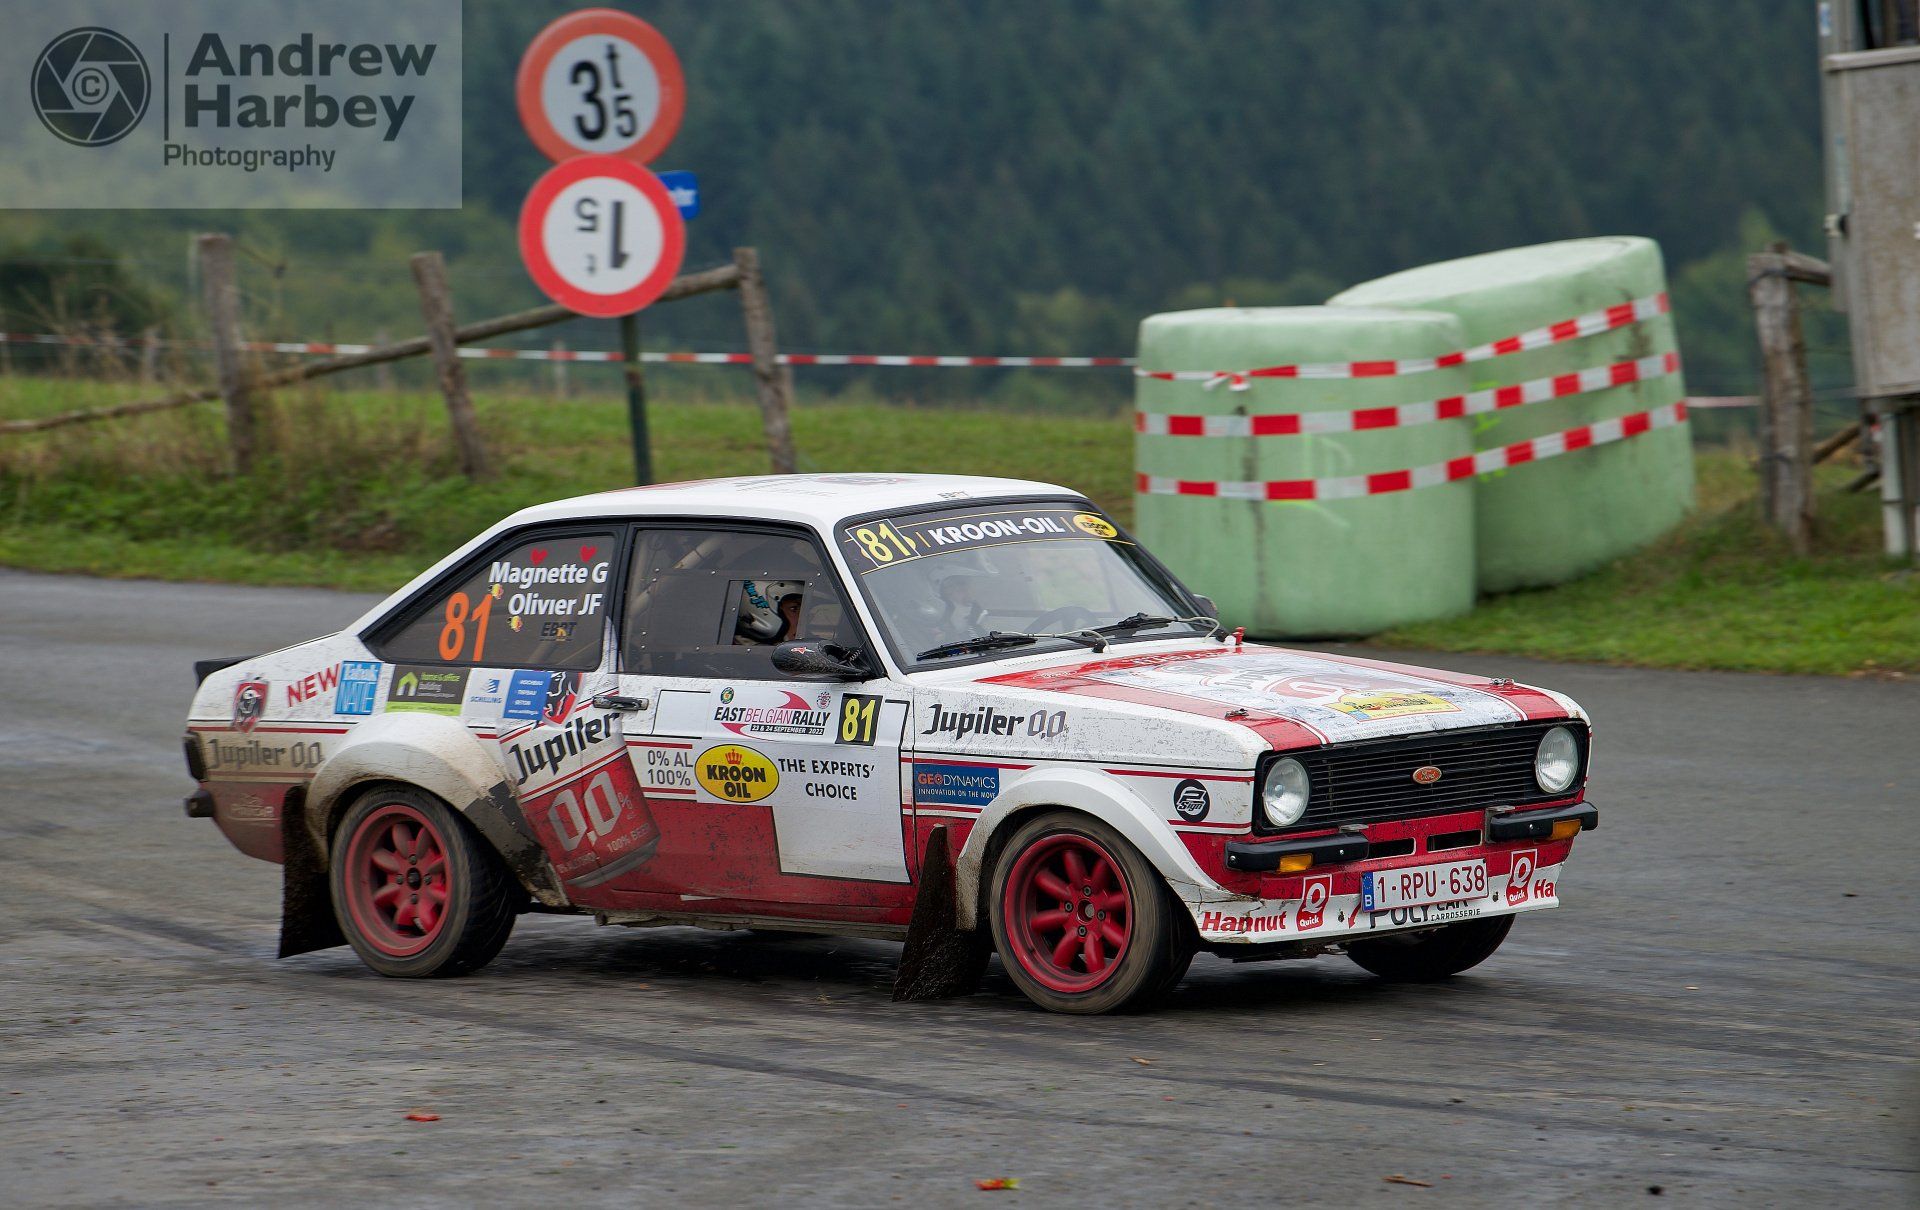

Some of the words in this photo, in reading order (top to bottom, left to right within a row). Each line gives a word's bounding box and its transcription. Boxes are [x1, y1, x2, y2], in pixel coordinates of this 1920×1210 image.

[927, 517, 1065, 546] KROON-OIL
[856, 523, 912, 562] 81
[489, 561, 588, 589] Magnette
[592, 562, 609, 583] G
[508, 593, 577, 616] Olivier
[578, 593, 603, 616] JF
[438, 591, 493, 662] 81
[287, 664, 340, 707] NEW
[773, 726, 807, 734] SEPTEMBER
[842, 698, 876, 742] 81
[920, 703, 1024, 741] Jupiler
[207, 738, 287, 769] Jupiler
[507, 711, 621, 786] Jupiler
[647, 749, 670, 767] 0%
[647, 769, 691, 787] 100%
[706, 764, 767, 783] KROON
[778, 757, 807, 773] THE
[812, 759, 875, 779] EXPERTS'
[724, 781, 751, 798] OIL
[917, 772, 996, 789] GEODYNAMICS
[805, 782, 857, 801] CHOICE
[918, 788, 956, 796] INNOVATION
[968, 790, 979, 798] THE
[1177, 800, 1203, 812] Sign
[1377, 864, 1485, 903] 1-RPU-638
[1533, 879, 1555, 899] Ha
[1364, 894, 1372, 907] B
[1509, 889, 1526, 902] Quick
[1201, 911, 1287, 932] Hannut
[1300, 917, 1320, 927] Quick
[1431, 908, 1481, 922] CARROSSERIE
